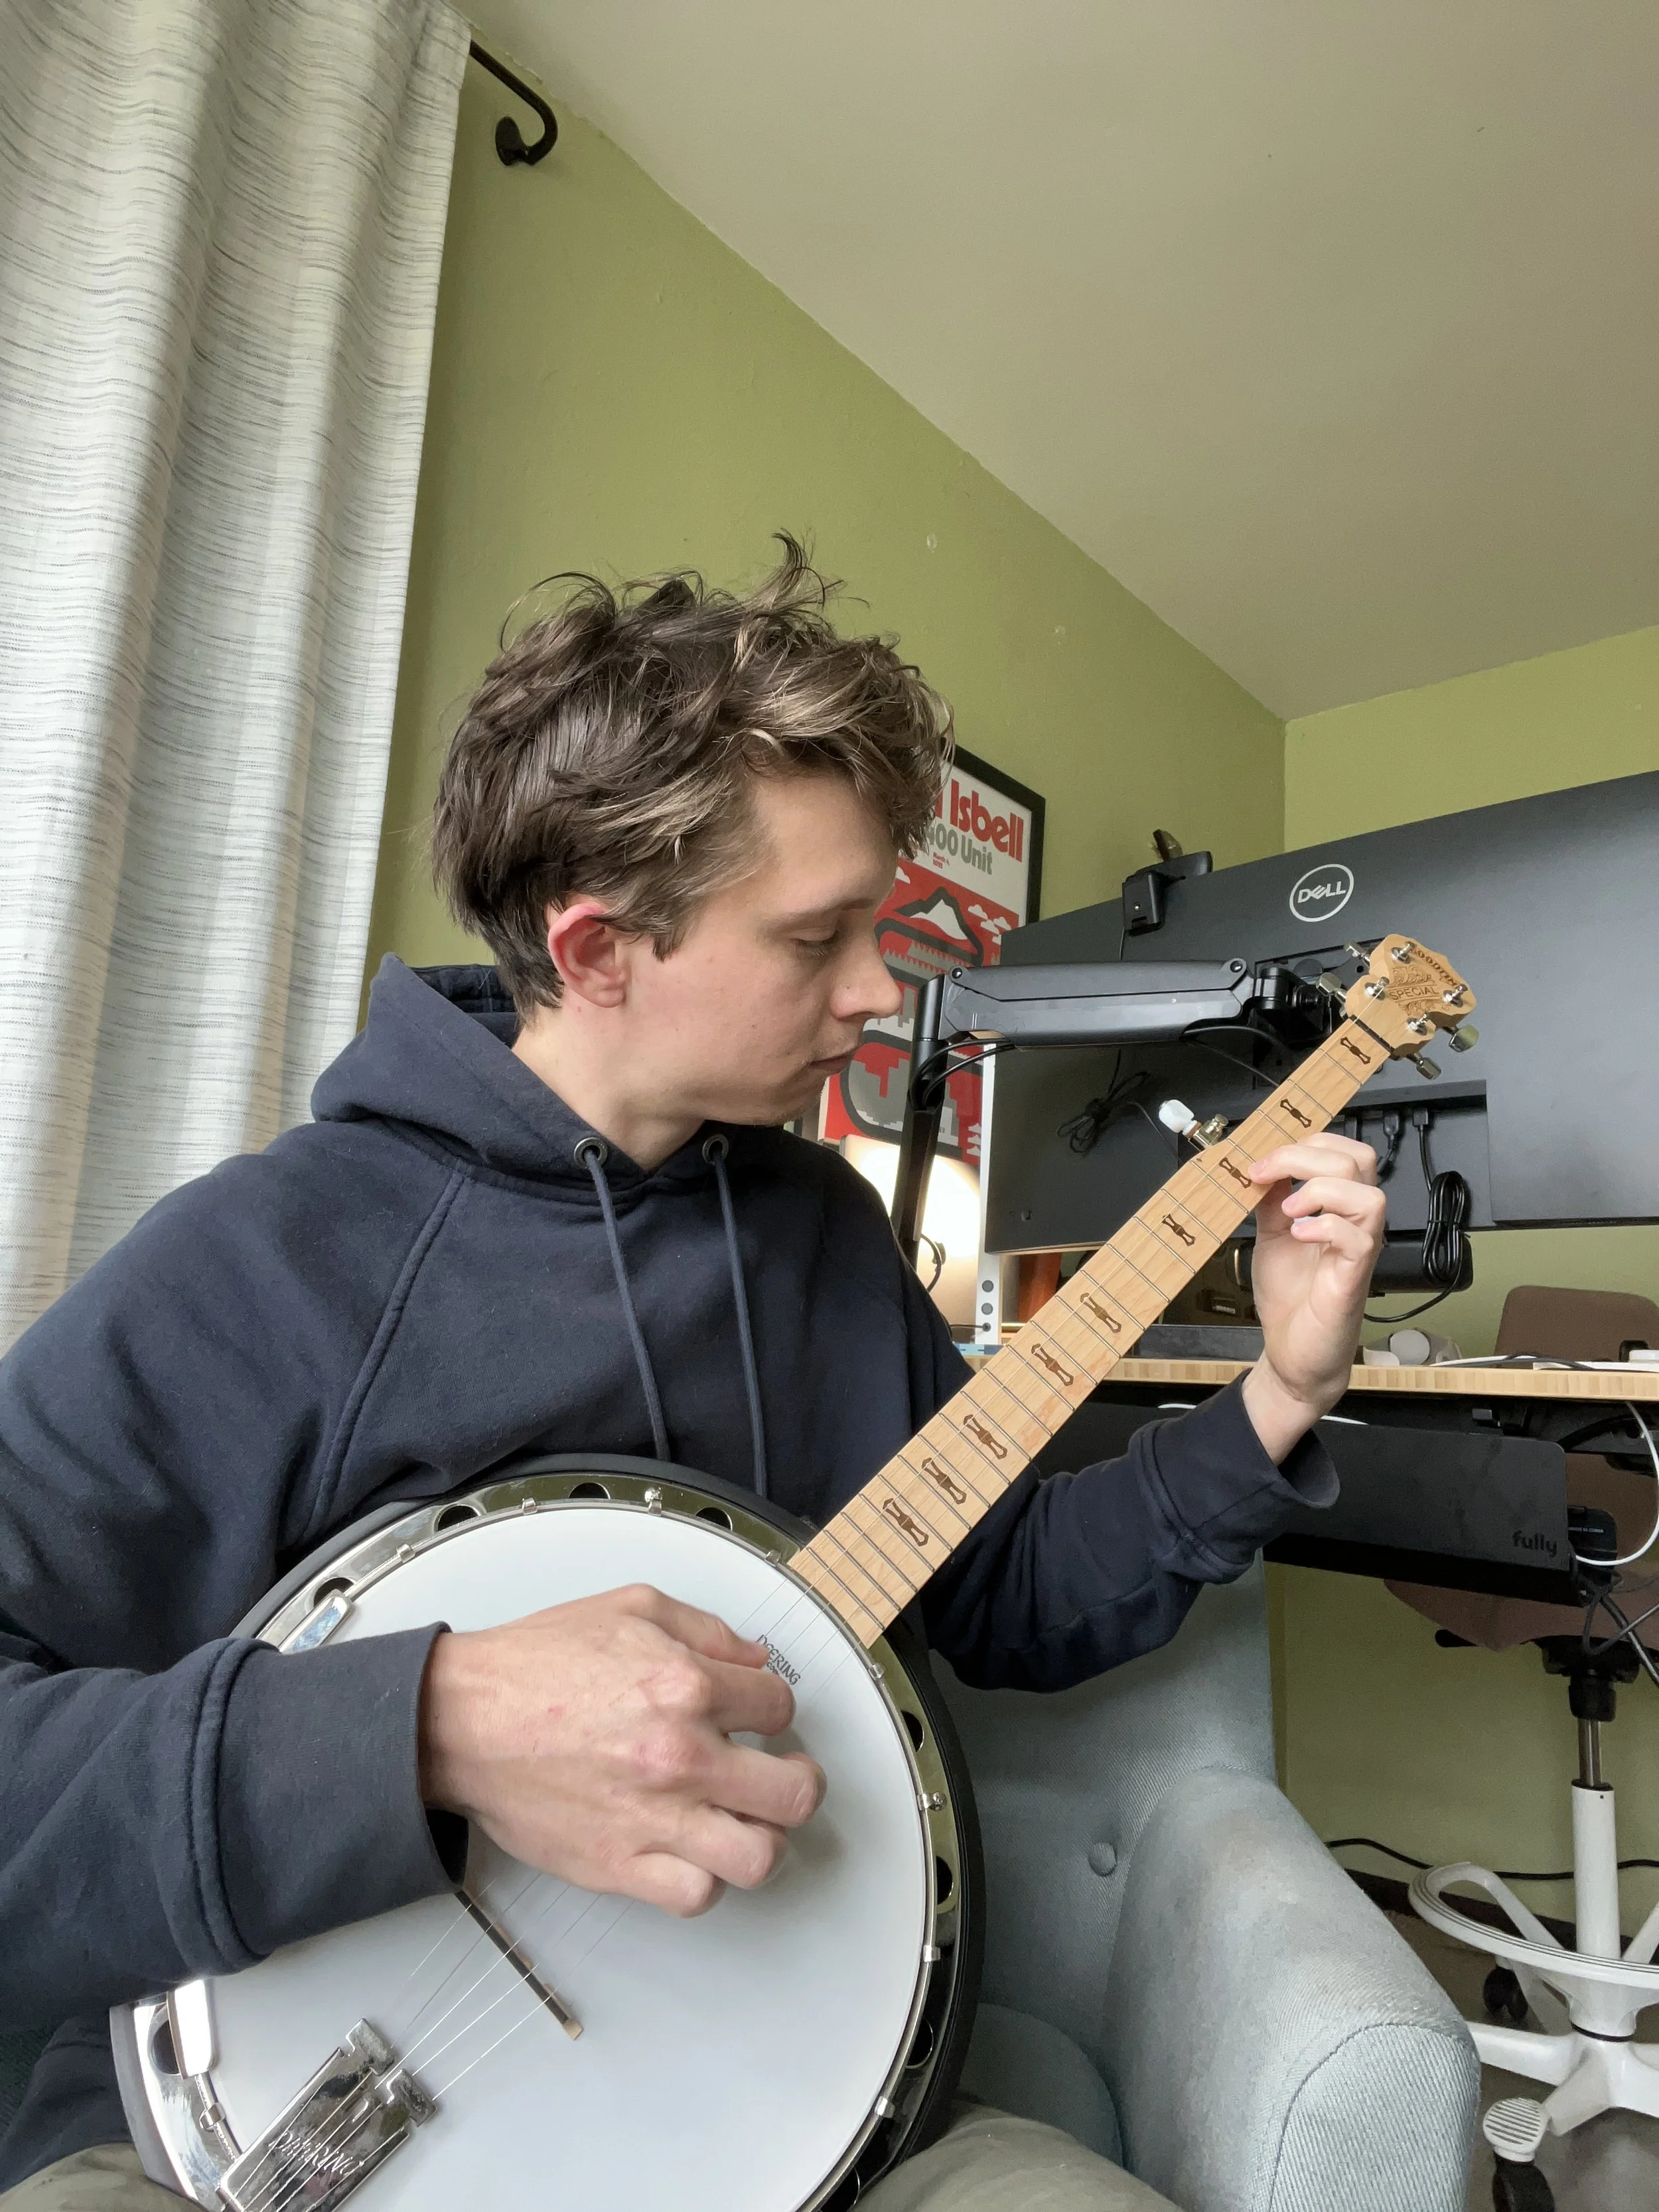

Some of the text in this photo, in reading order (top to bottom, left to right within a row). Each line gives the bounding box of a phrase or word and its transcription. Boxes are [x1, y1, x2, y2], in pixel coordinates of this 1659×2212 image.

[950, 778, 1024, 863] Isbell
[961, 835, 993, 875] Unit
[1298, 881, 1346, 903] DELL
[1389, 986, 1439, 1001] SPECIAL
[1512, 1529, 1557, 1558] fully
